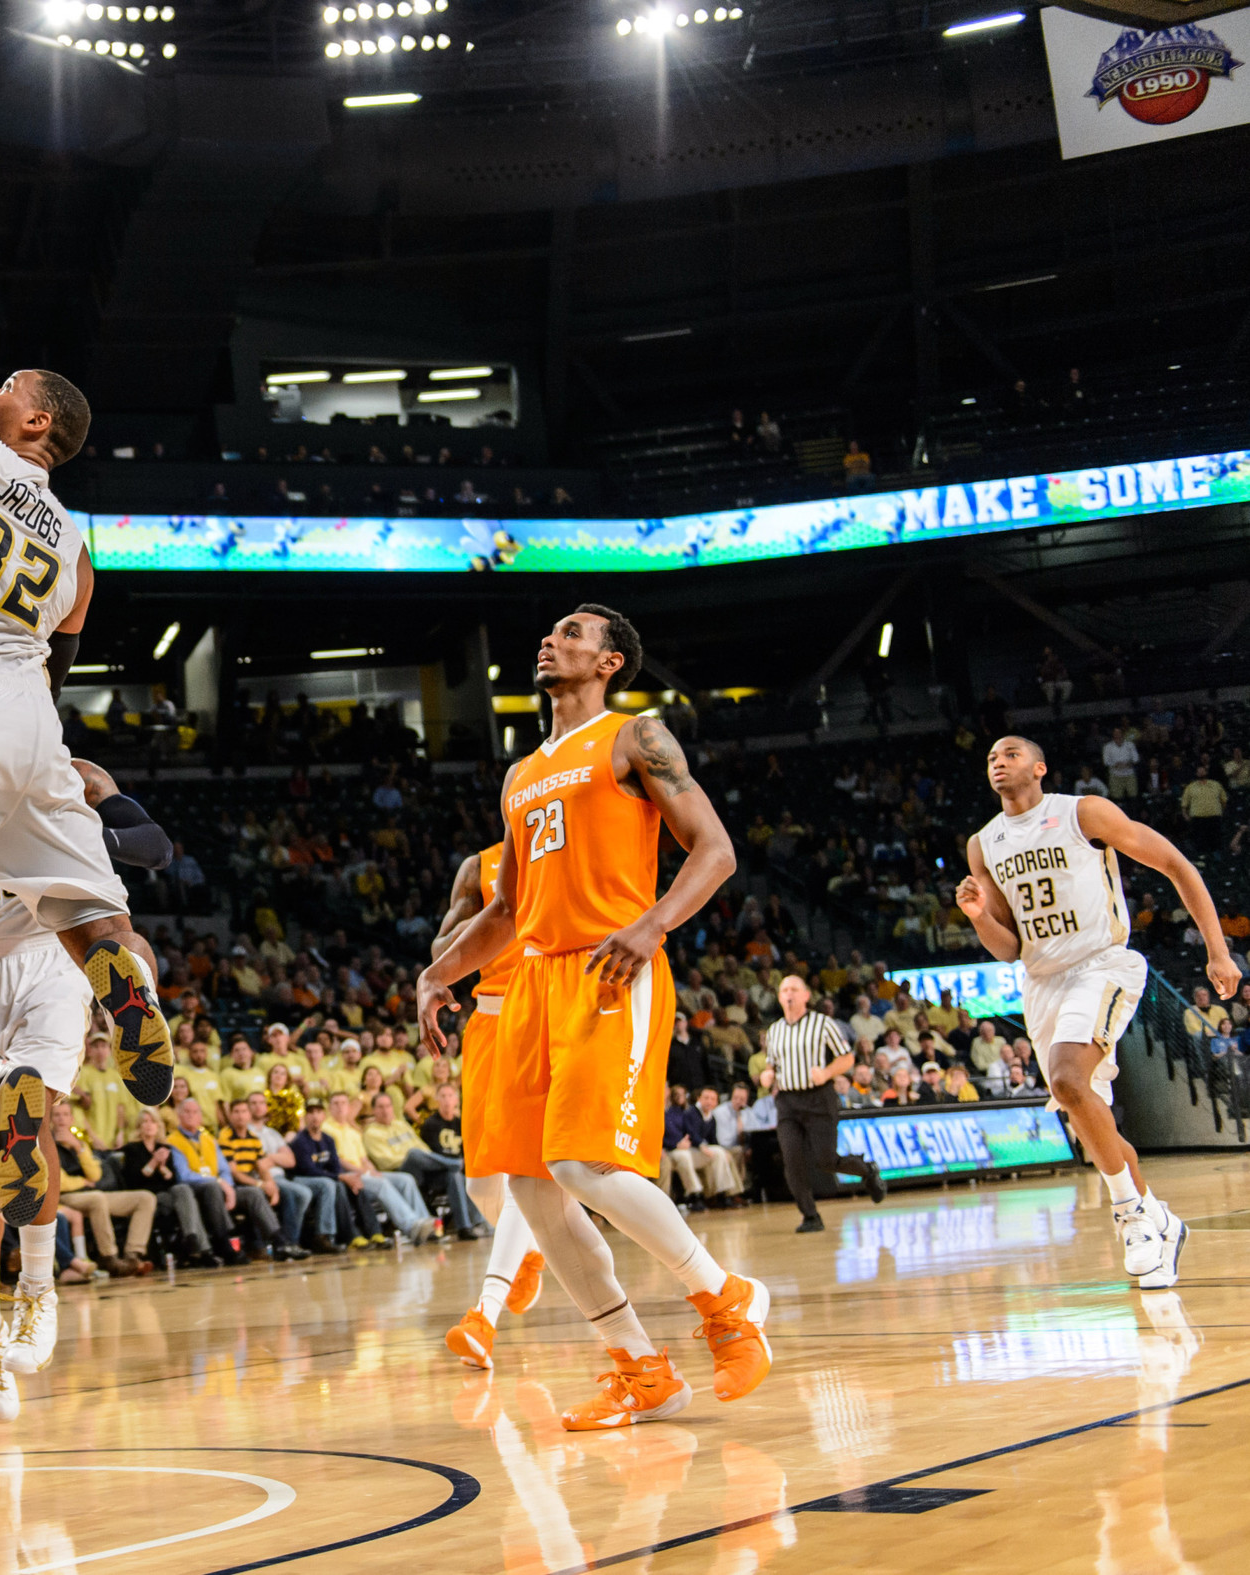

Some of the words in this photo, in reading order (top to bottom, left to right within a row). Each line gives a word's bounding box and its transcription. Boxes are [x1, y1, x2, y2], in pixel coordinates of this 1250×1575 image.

[1100, 59, 1138, 87] NCAA
[1138, 50, 1183, 68] FINAL
[1184, 49, 1224, 66] FOUR
[1134, 72, 1190, 96] 1990
[902, 475, 1040, 532] MAKE
[1078, 455, 1210, 512] SOME
[508, 765, 594, 813] TENNESSEE
[525, 798, 566, 863] 23
[995, 846, 1069, 885] GEORGIA
[1016, 877, 1056, 913] 33
[1021, 910, 1080, 942] TECH
[842, 1121, 924, 1170] MAKE
[917, 1117, 990, 1164] SOME
